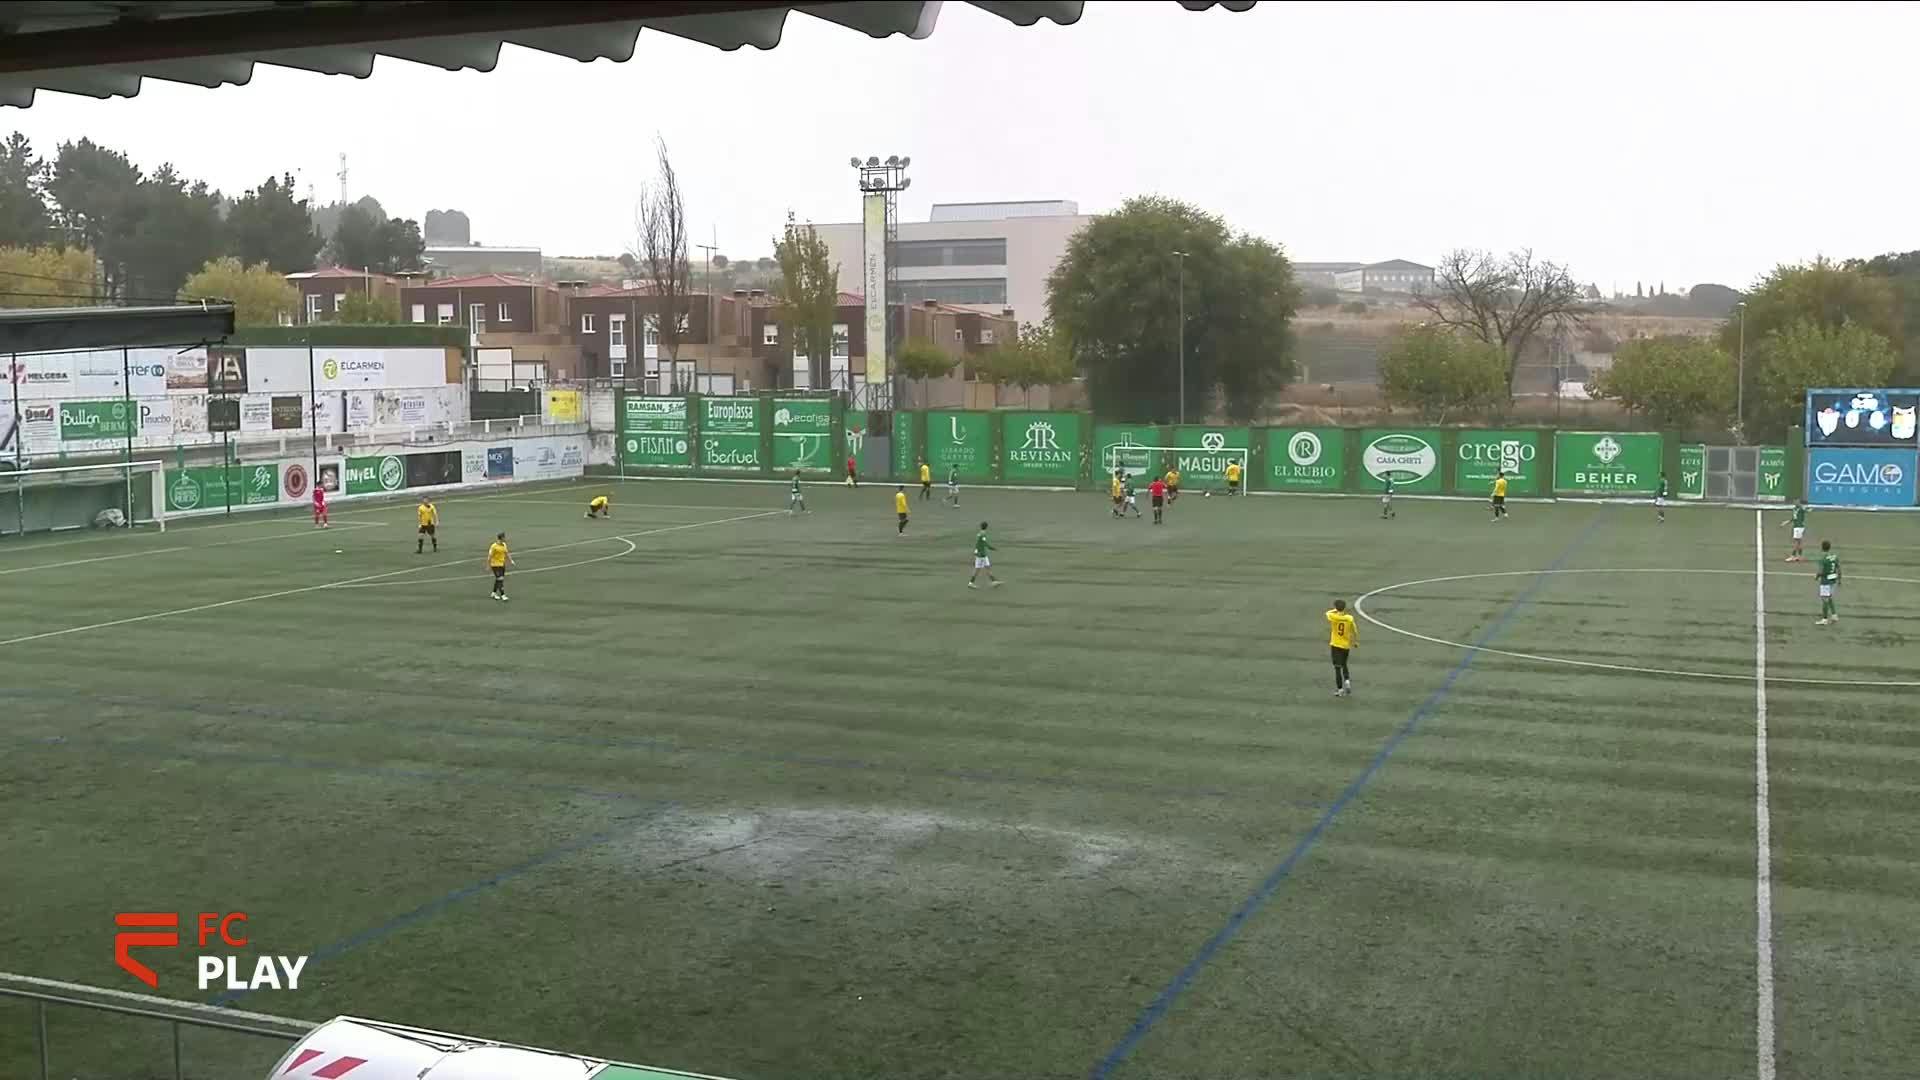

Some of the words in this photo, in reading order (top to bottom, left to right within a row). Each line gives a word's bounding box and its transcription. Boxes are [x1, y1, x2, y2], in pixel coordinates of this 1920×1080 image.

[341, 361, 384, 370] ELCARMEN
[708, 401, 753, 422] Europlassa
[640, 437, 674, 455] FISAN
[707, 448, 760, 464] iberfuel
[1010, 450, 1071, 461] REVISAN
[1376, 456, 1396, 464] CASA
[1459, 443, 1536, 468] crego
[1274, 466, 1291, 477] EL
[1294, 466, 1335, 477] RUBIO
[1575, 472, 1637, 484] BEHER
[1815, 462, 1903, 485] GAMO
[1337, 622, 1345, 637] 9
